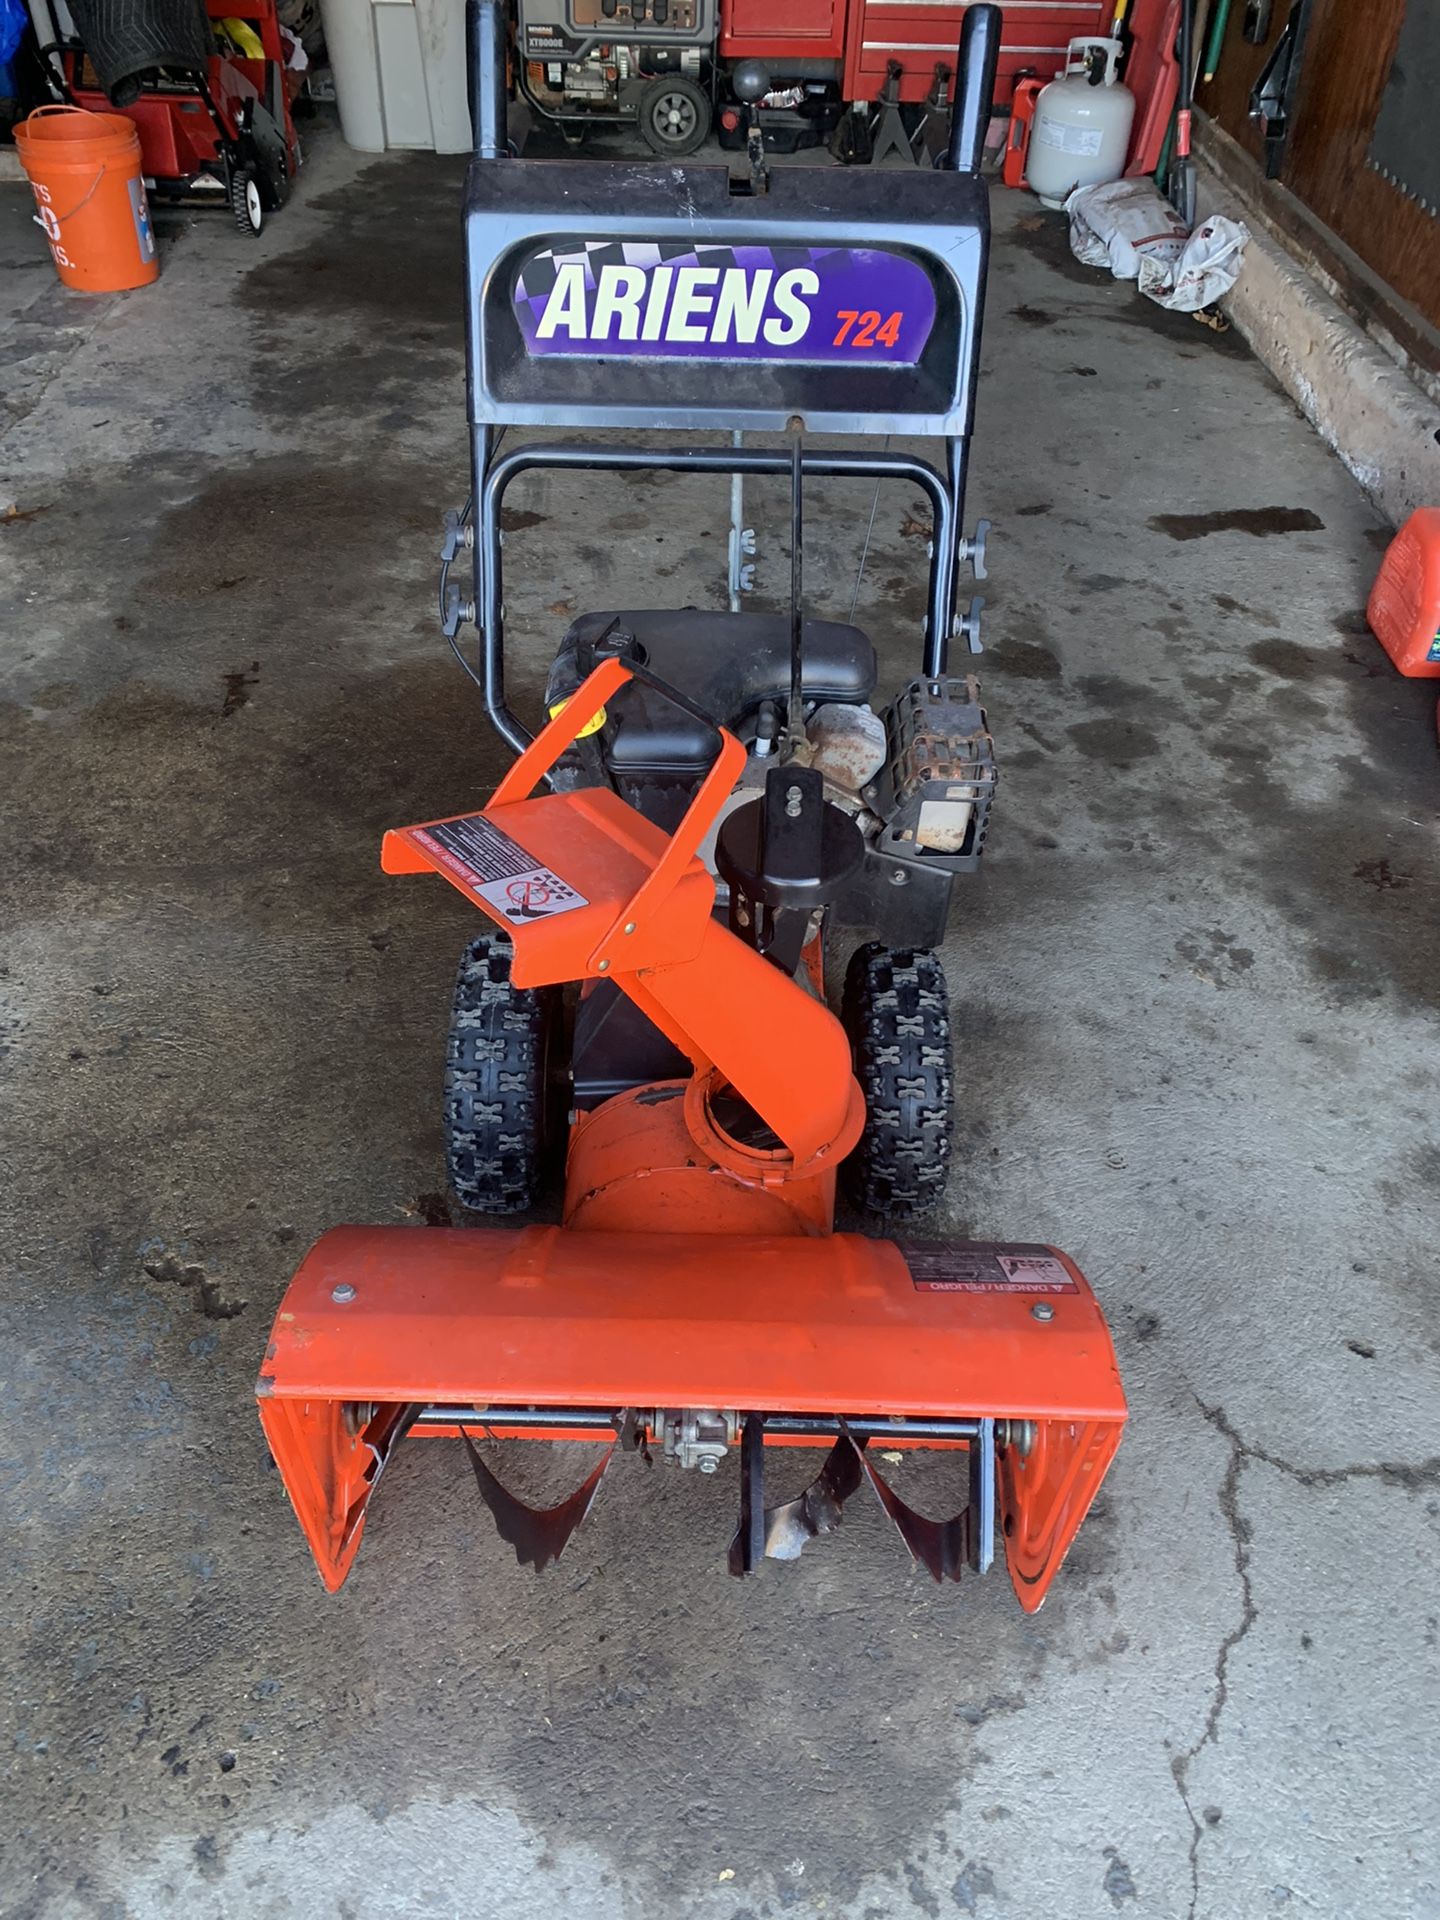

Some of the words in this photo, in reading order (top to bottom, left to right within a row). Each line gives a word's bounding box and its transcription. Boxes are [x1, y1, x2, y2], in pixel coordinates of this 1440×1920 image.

[535, 263, 820, 346] ARIENS
[832, 310, 904, 348] 724
[930, 1282, 985, 1291] PELIGRO
[995, 1283, 1048, 1292] DANGER
